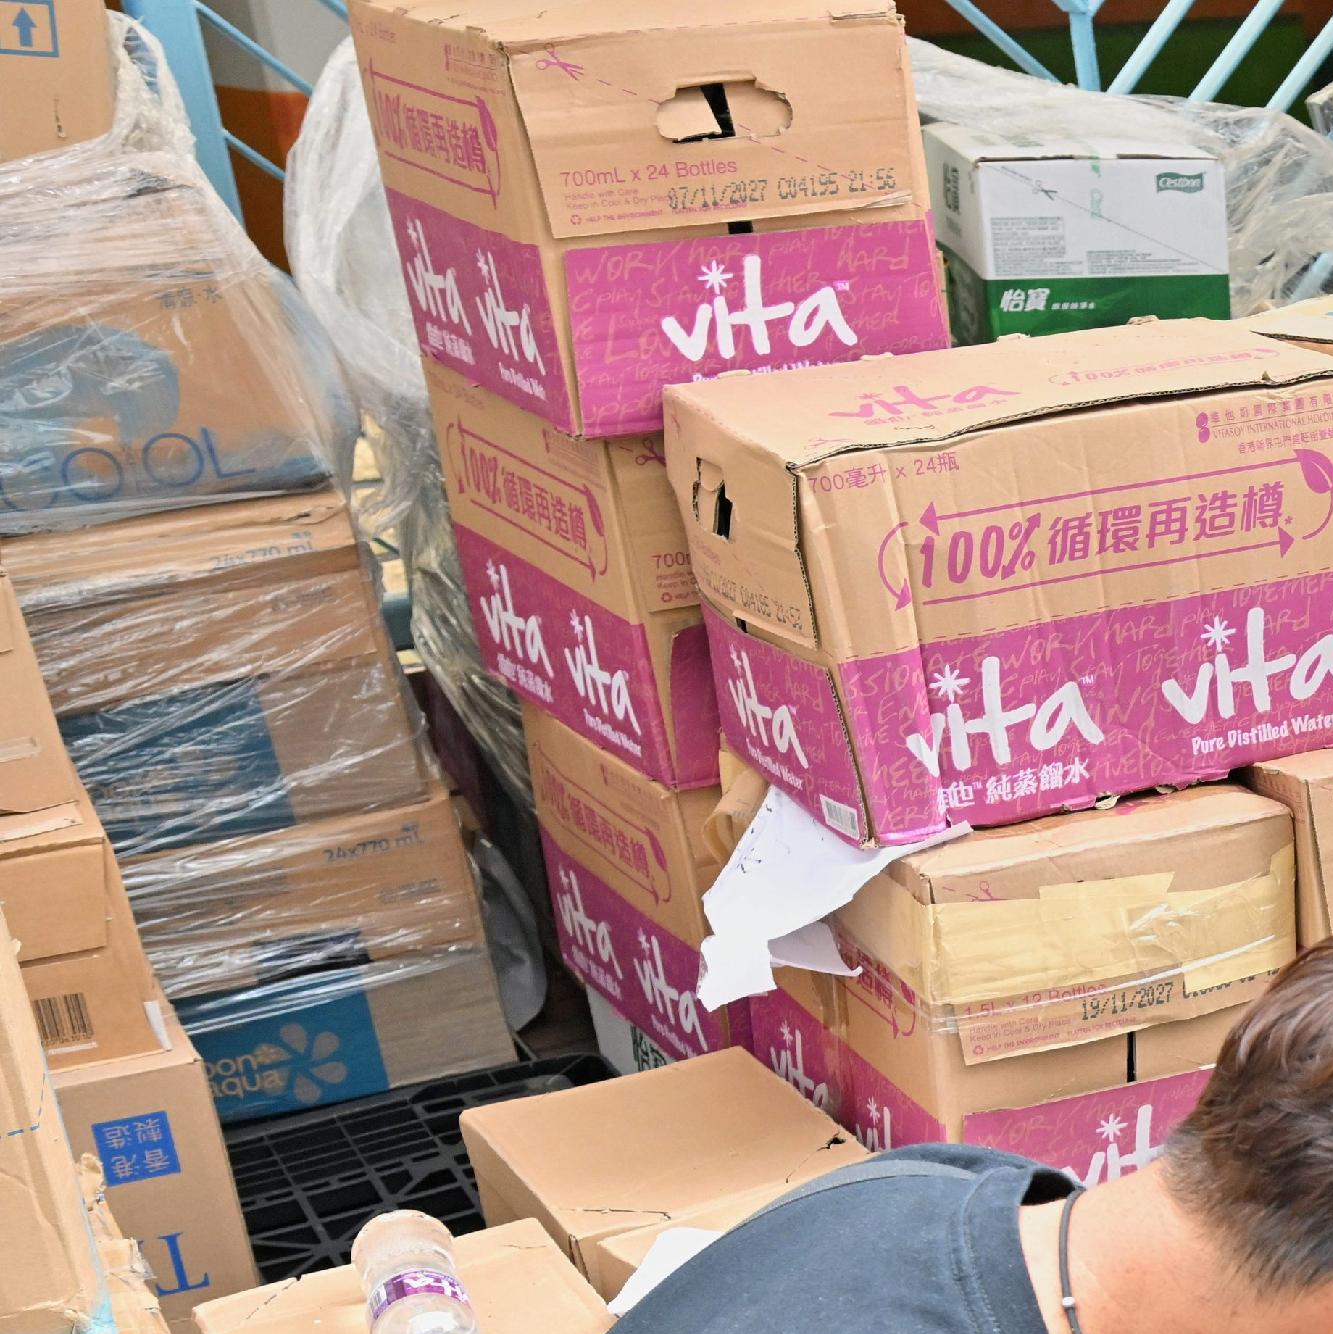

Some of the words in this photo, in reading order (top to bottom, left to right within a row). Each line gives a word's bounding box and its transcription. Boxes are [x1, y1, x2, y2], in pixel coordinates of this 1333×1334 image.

[560, 166, 627, 188] 700mL
[645, 162, 671, 180] 24
[675, 157, 738, 178] Bottles
[406, 216, 473, 336] vita
[476, 248, 547, 376] vita
[661, 254, 858, 362] vita
[1000, 287, 1050, 313] 怡寶
[829, 384, 1022, 418] vita
[808, 463, 887, 494] 700毫升
[914, 450, 960, 475] 24瓶
[653, 550, 691, 570] 700
[480, 558, 554, 679] vita
[564, 608, 642, 737] vita
[727, 644, 809, 769] vita
[905, 656, 1105, 778] vita
[1192, 735, 1225, 755] Pure
[1227, 721, 1288, 750] Distilled
[557, 863, 624, 980] vita
[633, 926, 709, 1052] vita
[1080, 981, 1174, 1021] 19/11/2027
[1061, 1103, 1166, 1187] vit
